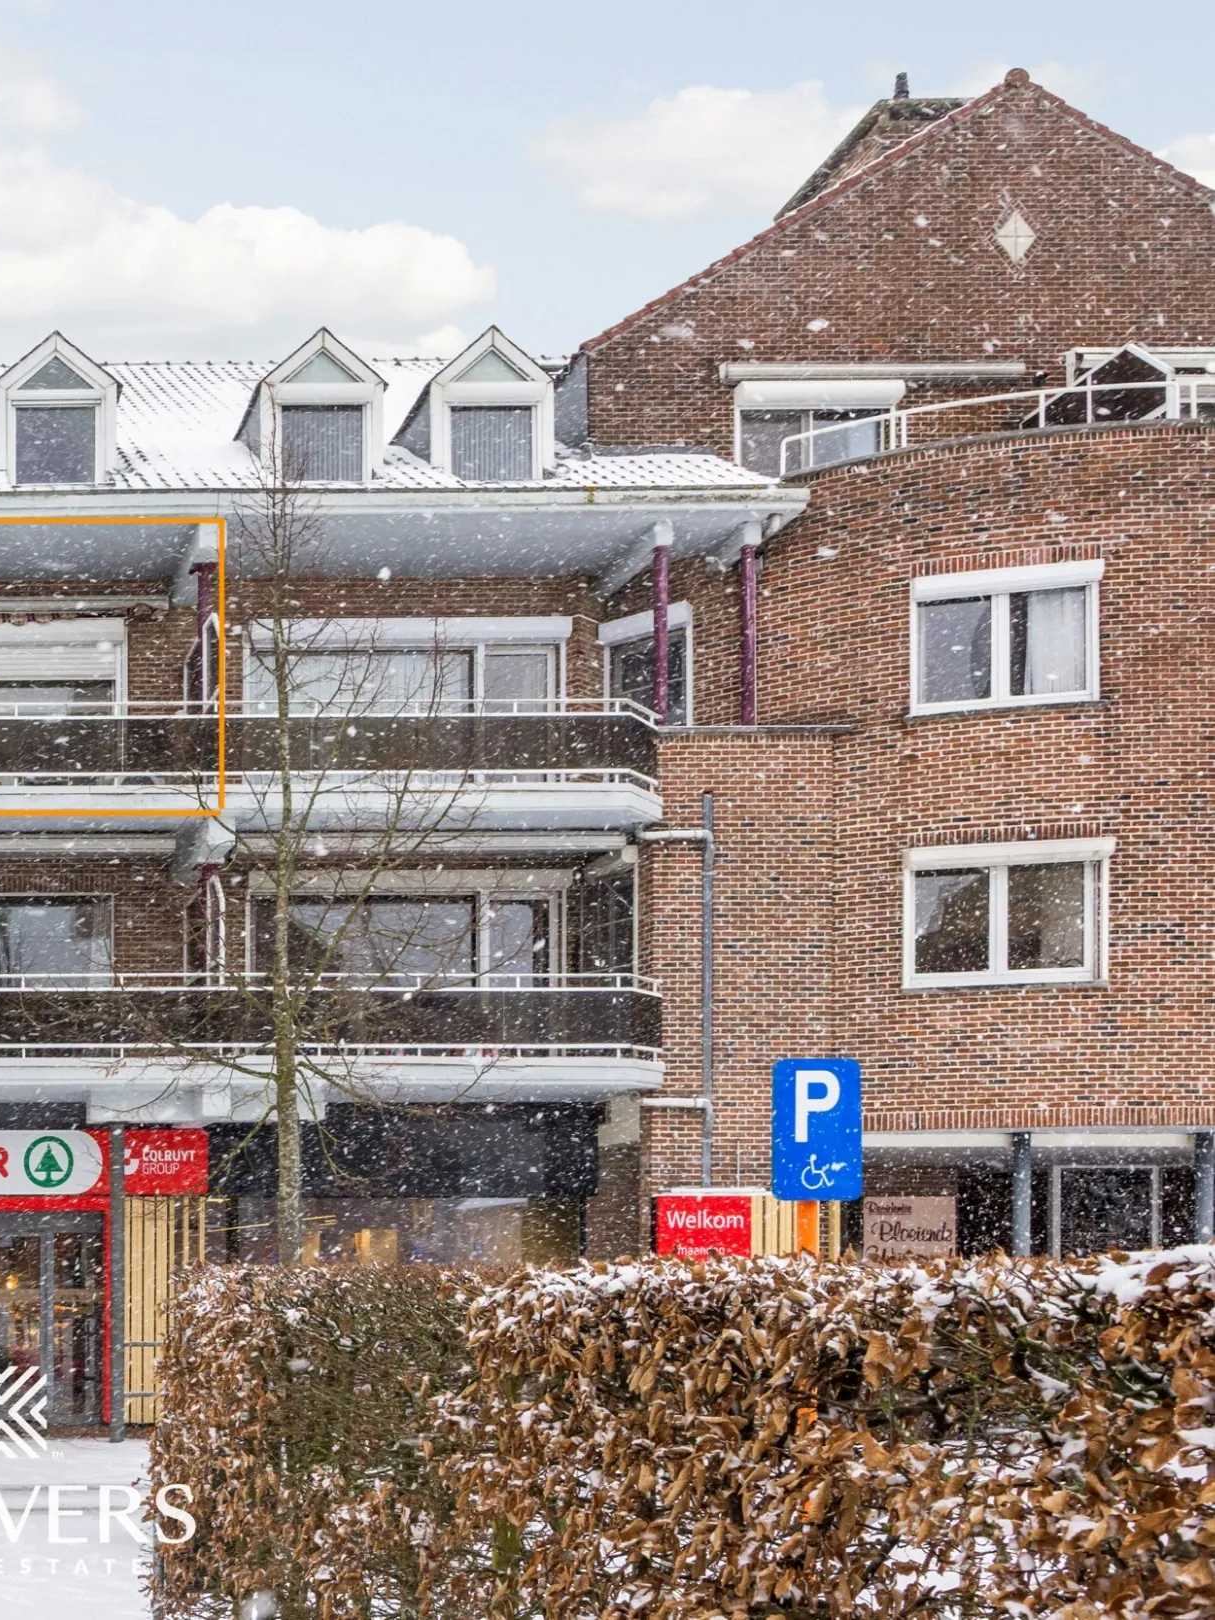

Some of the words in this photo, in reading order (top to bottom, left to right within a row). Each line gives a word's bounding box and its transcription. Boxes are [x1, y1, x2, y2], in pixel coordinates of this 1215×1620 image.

[795, 1070, 840, 1143] P
[142, 1148, 196, 1162] COLRUYT
[142, 1162, 180, 1175] GROUP
[666, 1209, 745, 1229] Welkom
